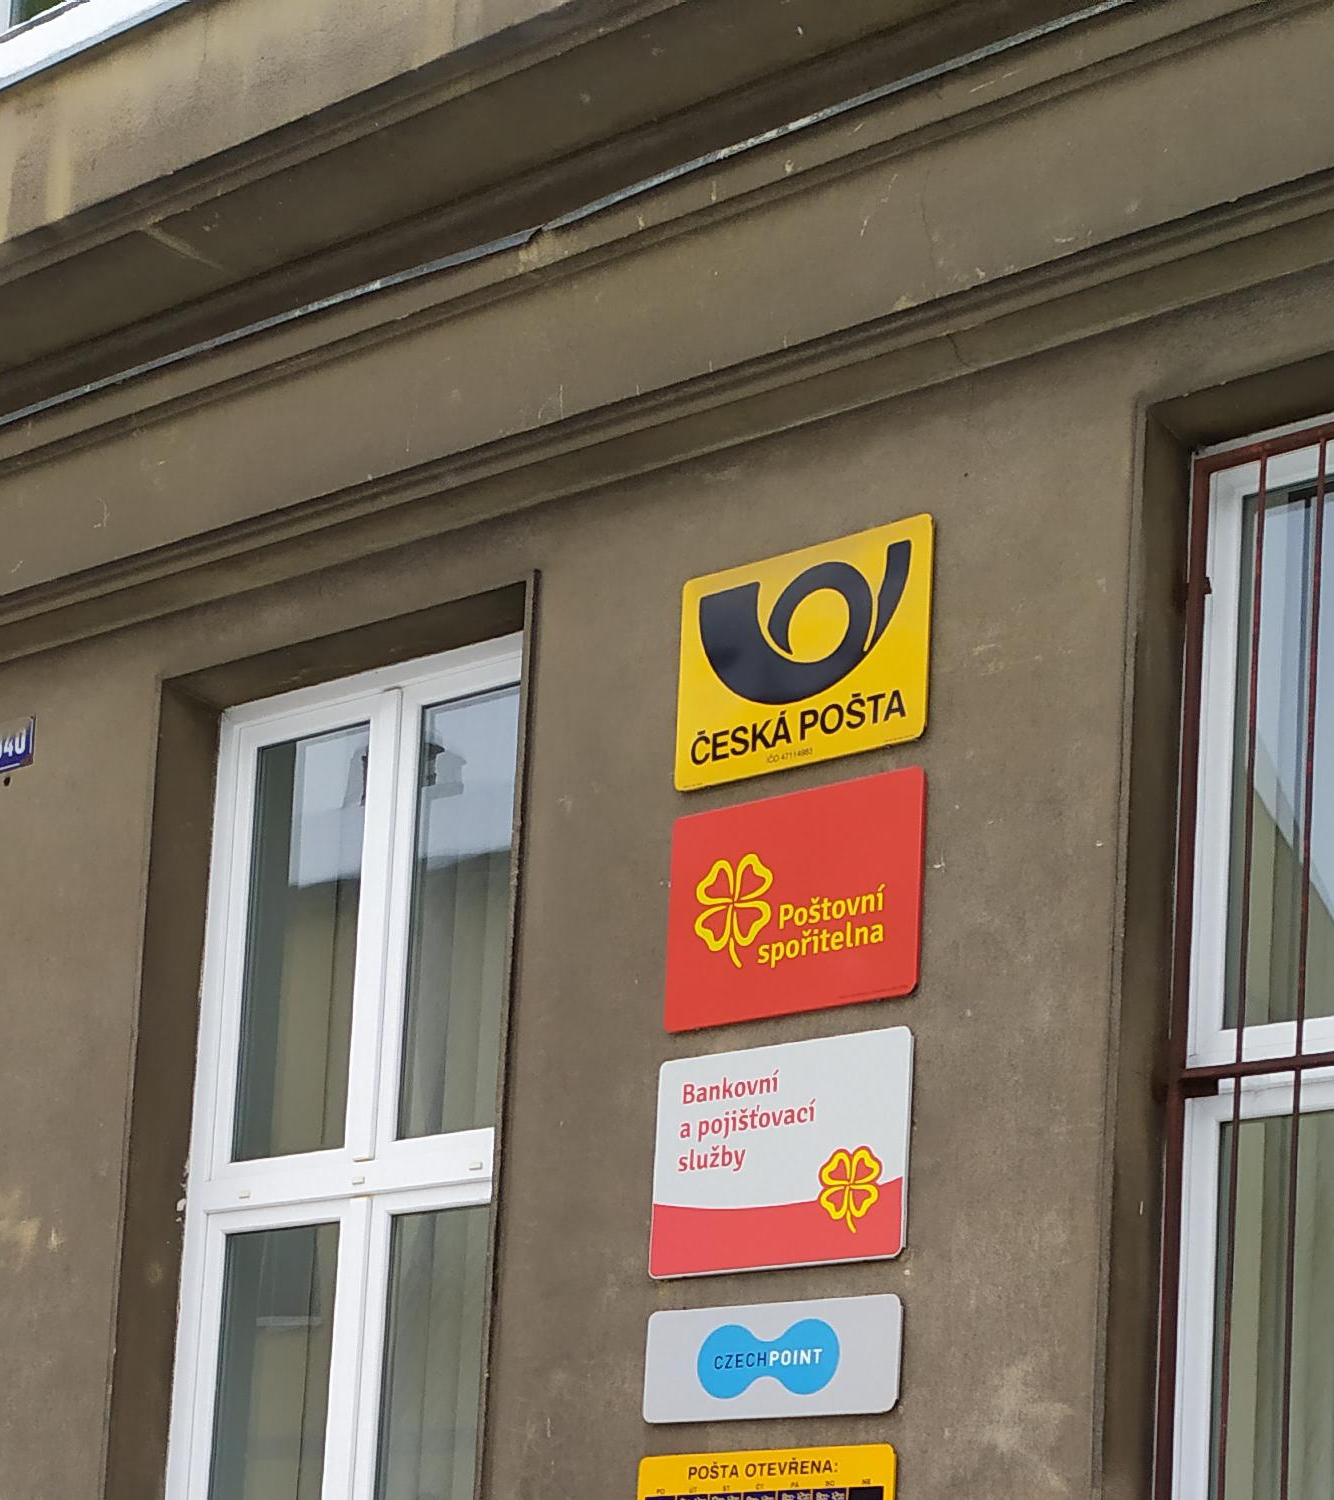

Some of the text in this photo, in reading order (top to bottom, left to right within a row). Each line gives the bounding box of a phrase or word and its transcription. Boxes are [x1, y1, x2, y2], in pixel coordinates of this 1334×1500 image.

[690, 689, 907, 766] ČESKÁ POŠTA
[778, 883, 886, 930] Poštovní
[757, 921, 884, 969] spořitelna
[682, 1069, 780, 1105] Bankovní
[679, 1098, 816, 1142] a pojišťovací
[677, 1144, 746, 1172] služby
[687, 1457, 839, 1480] POŠTA OTEVŘENA:
